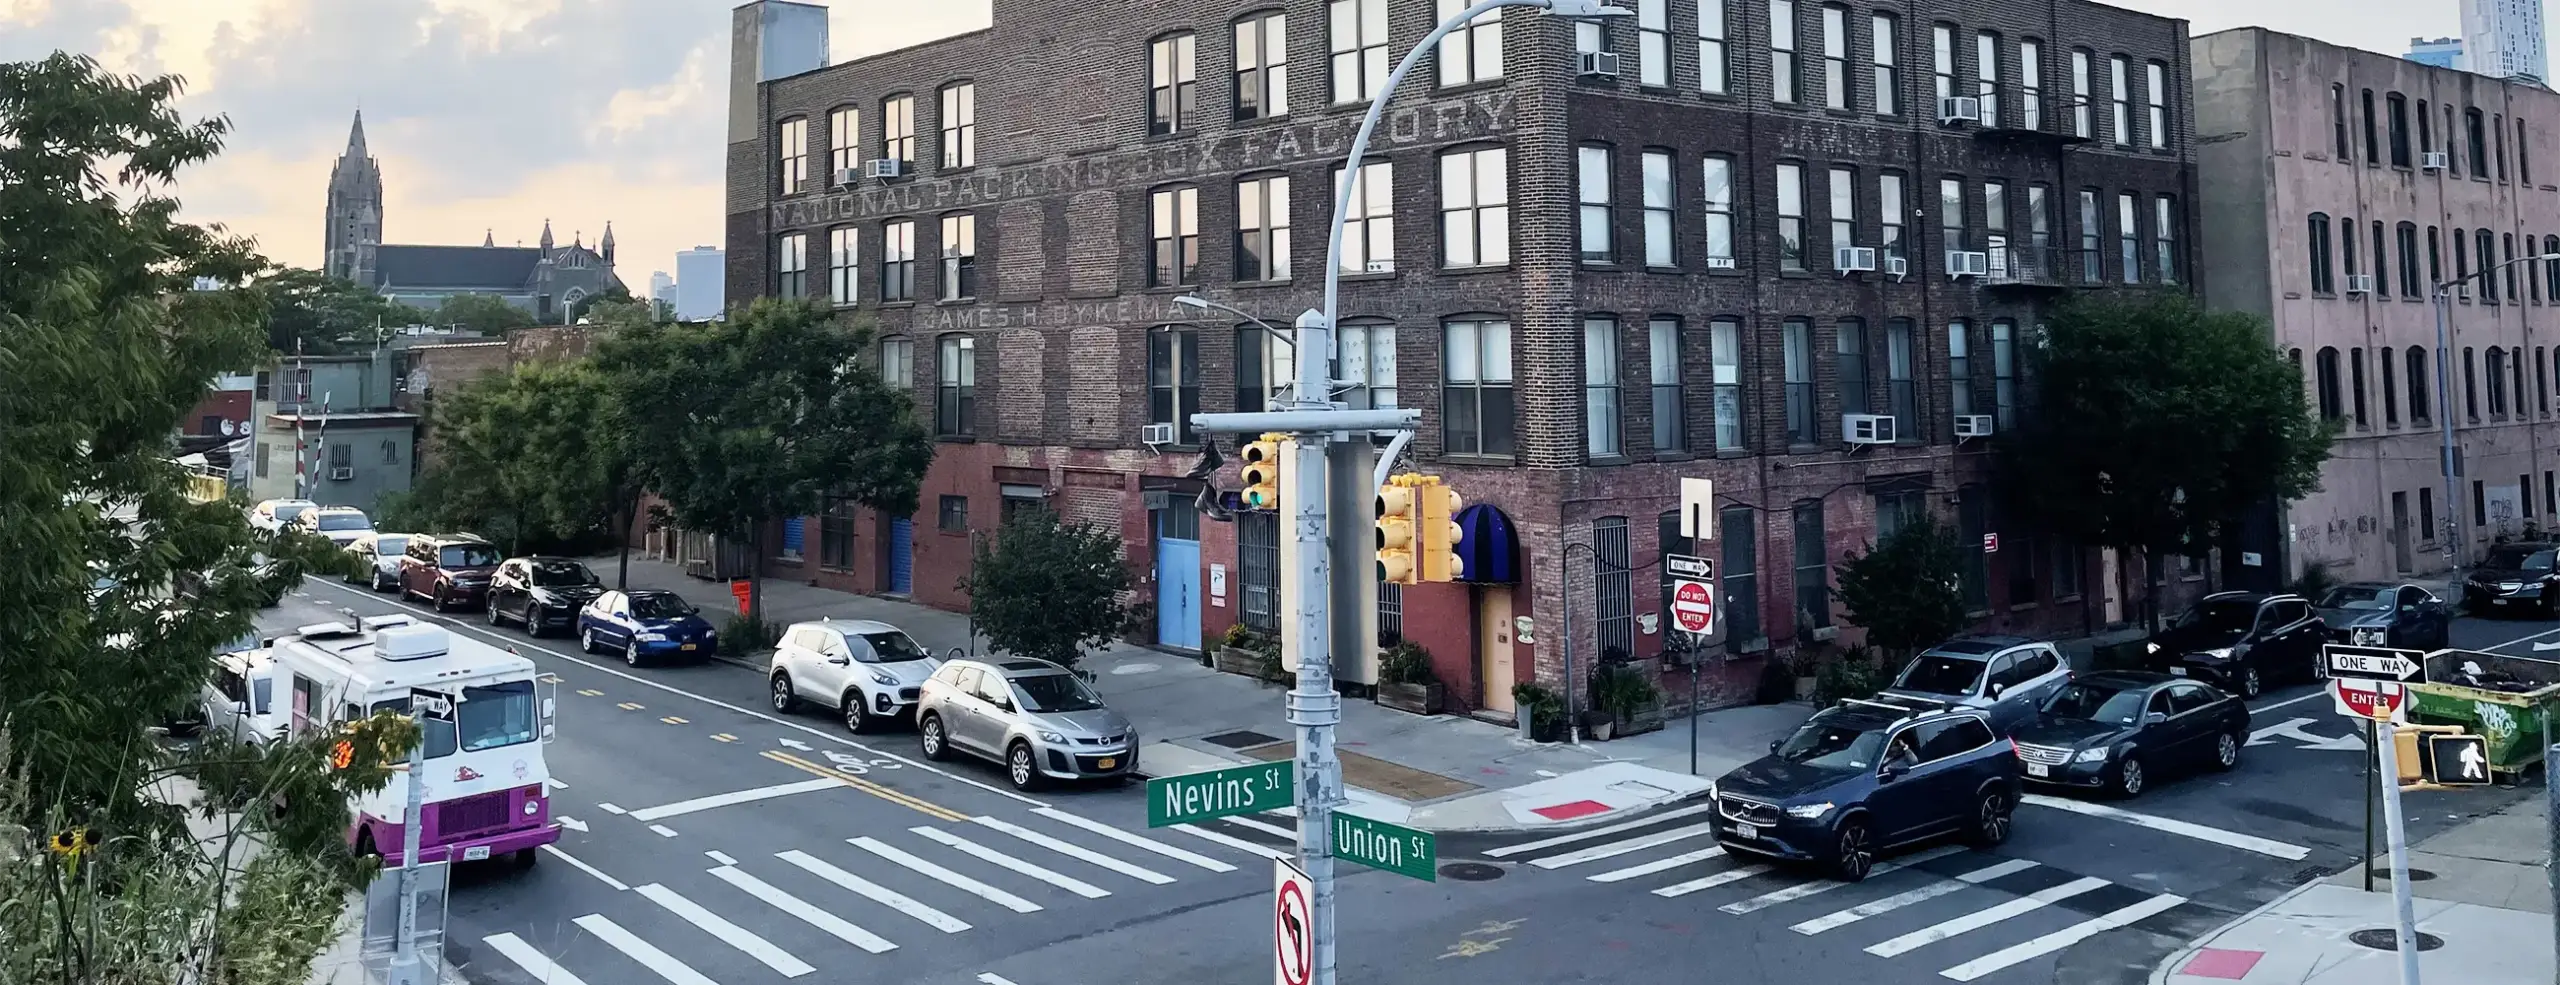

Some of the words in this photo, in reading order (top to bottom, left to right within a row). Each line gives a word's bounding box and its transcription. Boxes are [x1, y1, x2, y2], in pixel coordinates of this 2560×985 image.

[772, 186, 921, 227] NATIONAL
[934, 156, 1111, 207] PACKING
[924, 303, 1009, 329] JAMES
[1674, 561, 1686, 570] ONE
[1692, 564, 1706, 572] WAY
[1681, 591, 1691, 599] DO
[1692, 592, 1705, 601] NOT
[1682, 613, 1704, 623] ENTER
[2340, 656, 2367, 670] ONE
[2380, 659, 2409, 673] WAY
[434, 701, 449, 712] WAY
[1166, 773, 1254, 818] Nevins
[1265, 767, 1280, 791] St
[1338, 818, 1402, 867] Union
[1411, 835, 1426, 860] St
